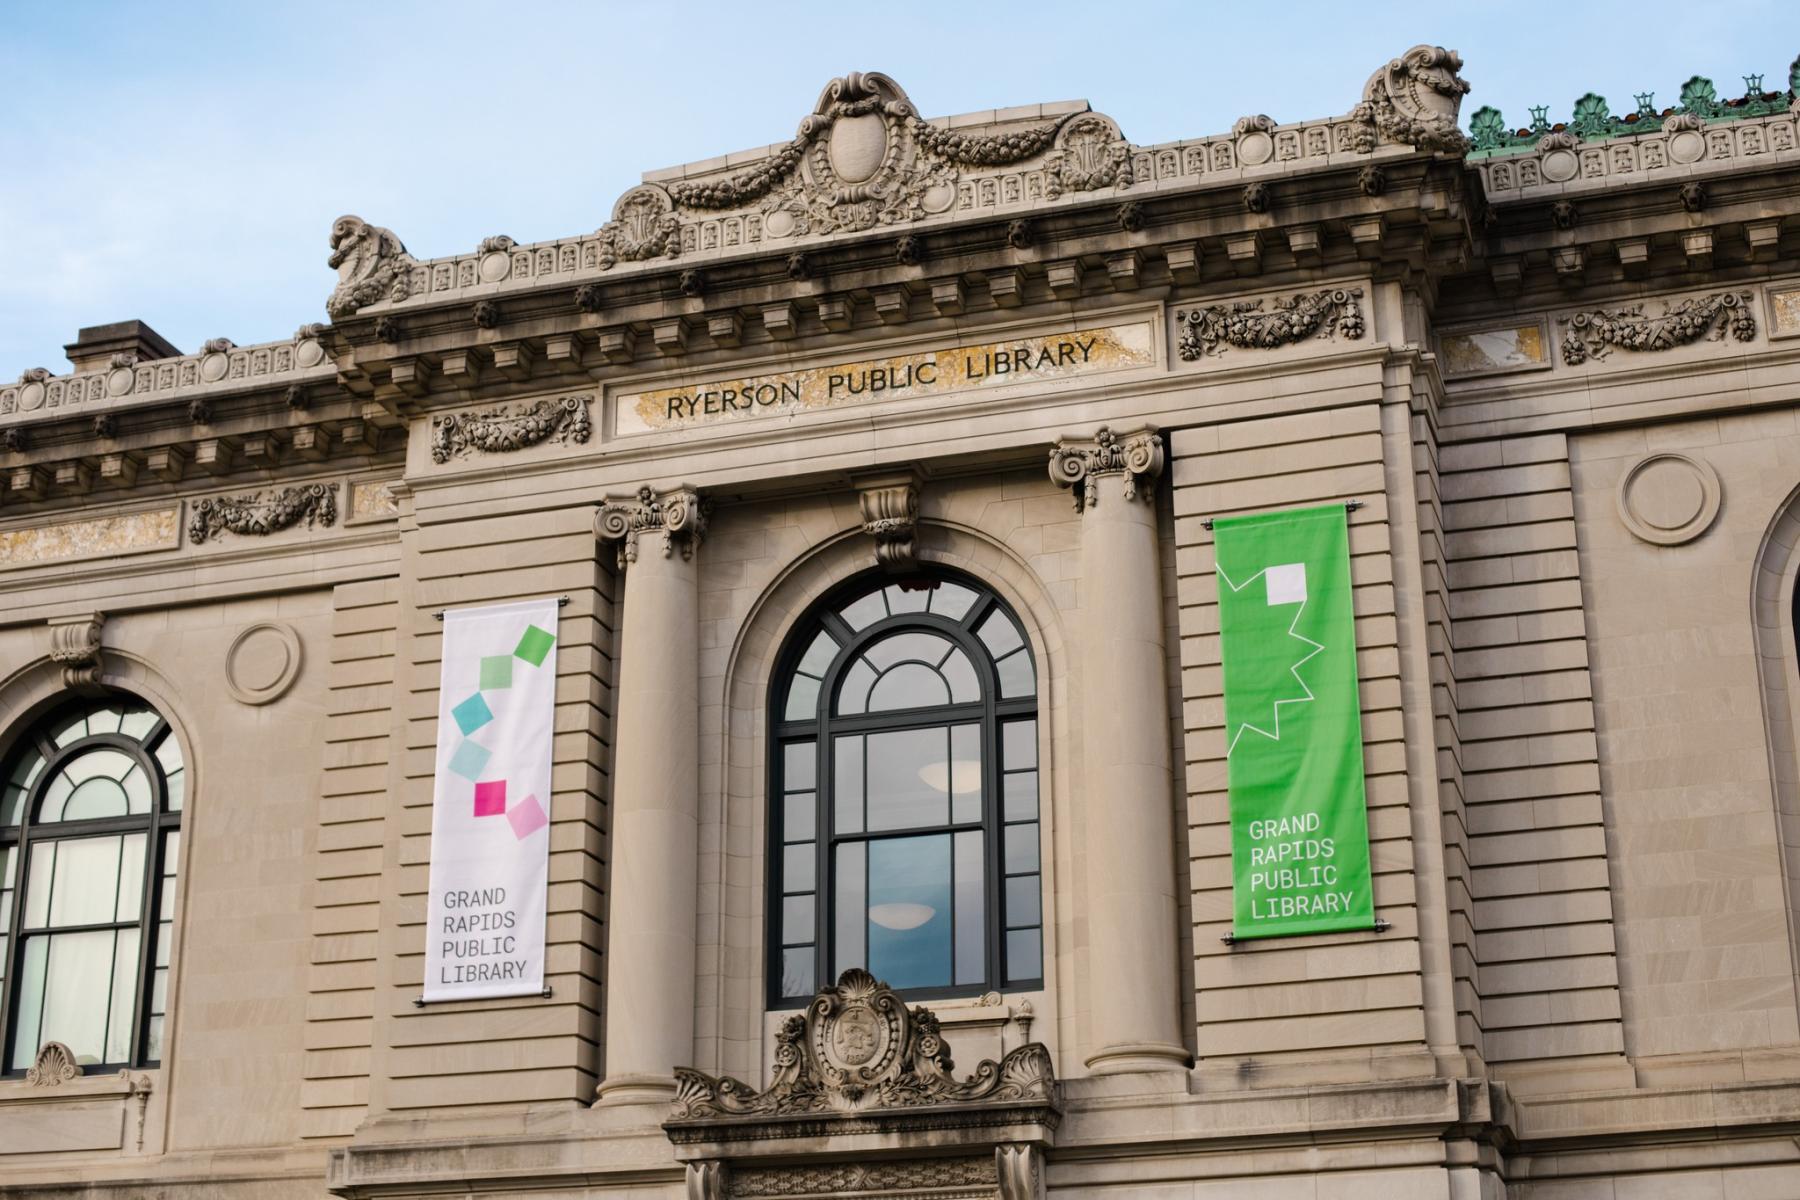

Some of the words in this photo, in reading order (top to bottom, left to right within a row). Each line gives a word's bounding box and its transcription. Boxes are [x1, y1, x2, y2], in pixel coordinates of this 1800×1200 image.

[667, 380, 800, 419] RYERSON
[827, 361, 937, 398] PUBLIC
[965, 337, 1098, 379] LIBRARY
[1249, 812, 1320, 841] GRAND
[1251, 838, 1334, 867] RAPIDS
[1251, 865, 1337, 892] PUBLIC
[444, 887, 506, 909] GRAND
[1252, 891, 1353, 919] LIBRARY
[443, 911, 516, 934] RAPIDS
[442, 936, 516, 959] PUBLIC
[441, 960, 527, 984] LIBRARY
